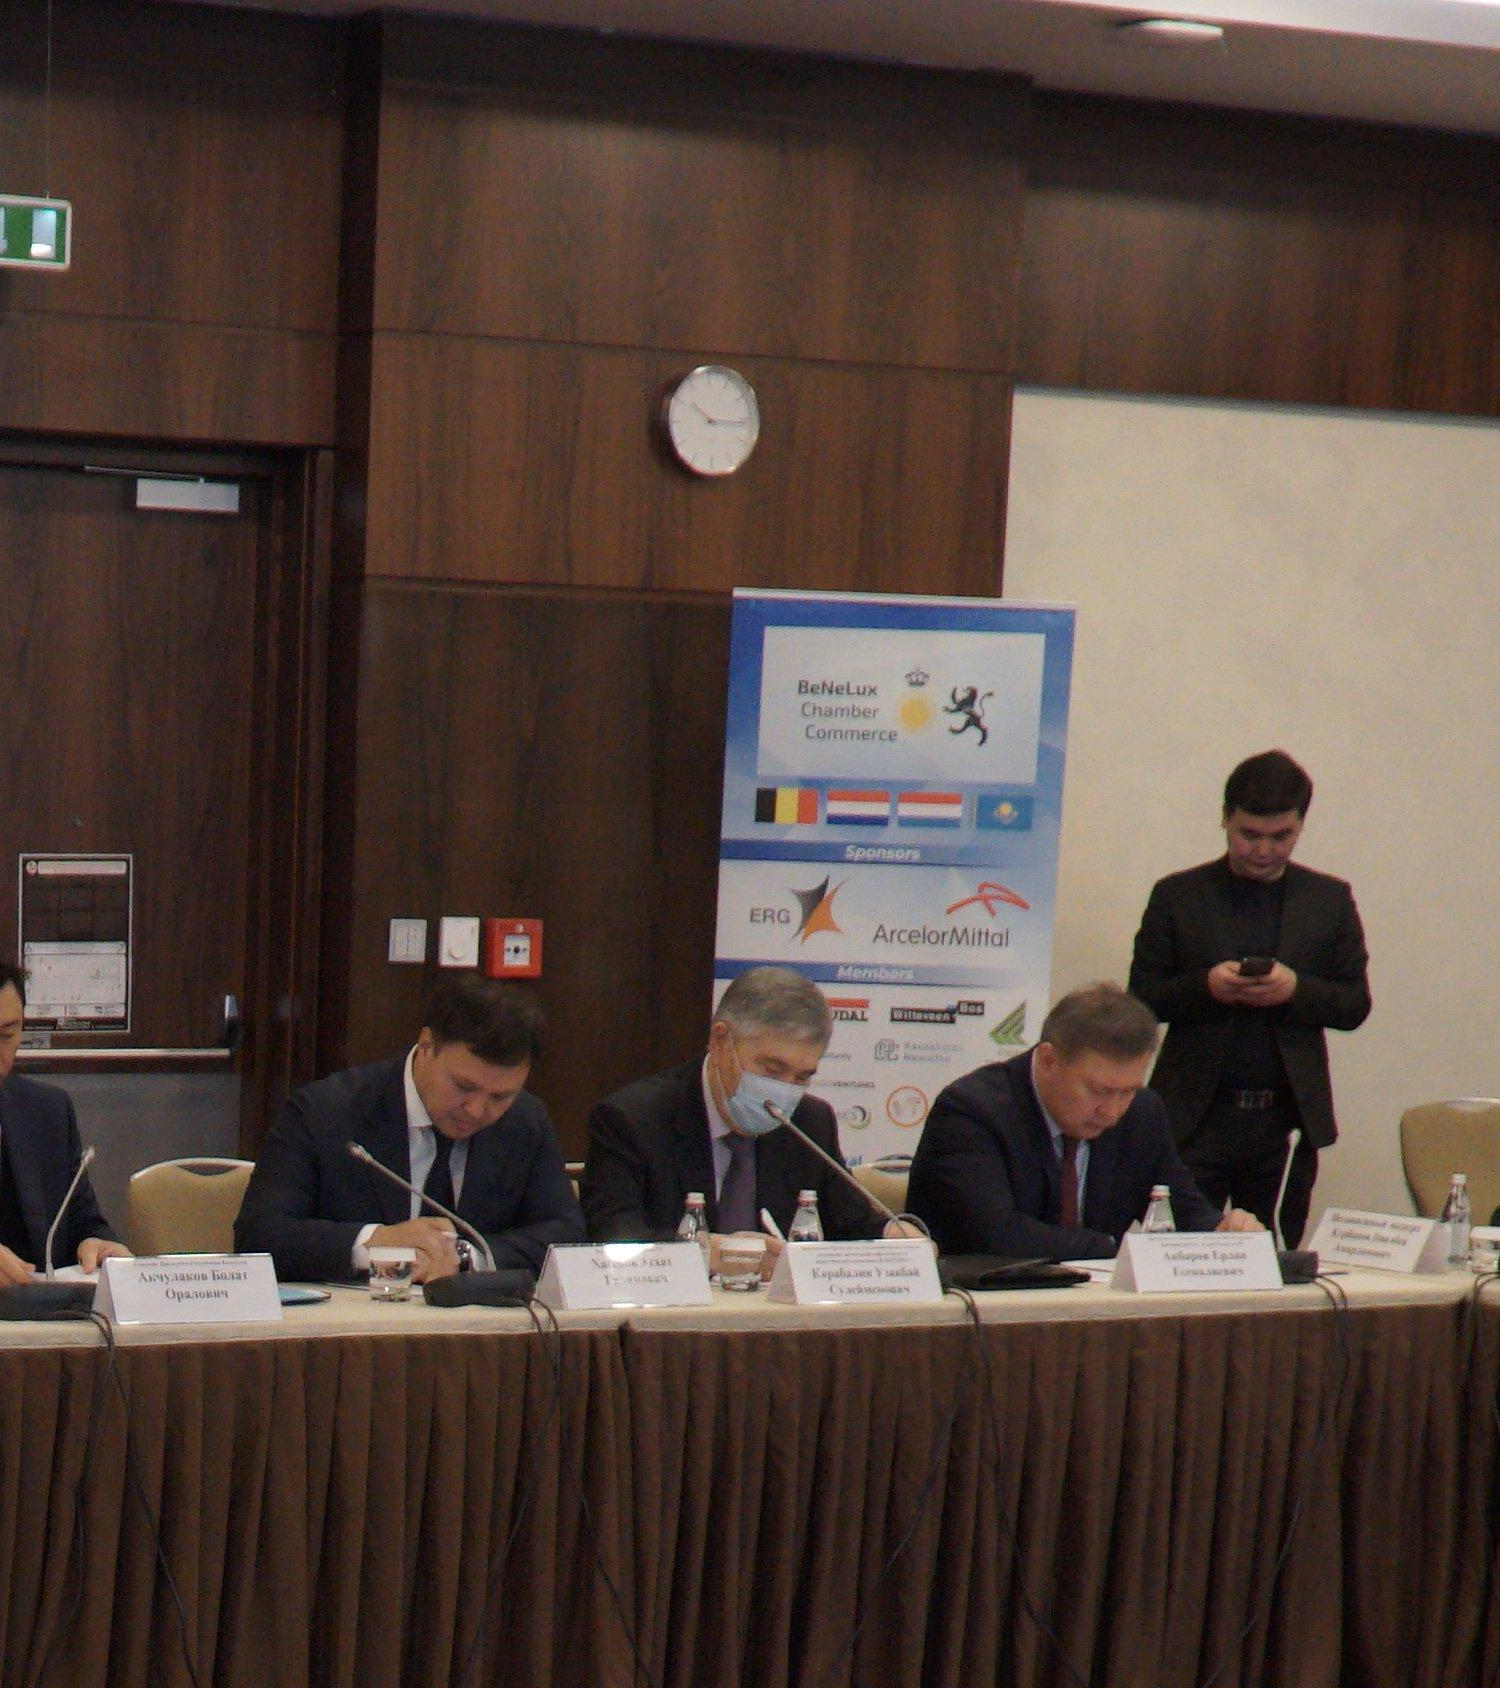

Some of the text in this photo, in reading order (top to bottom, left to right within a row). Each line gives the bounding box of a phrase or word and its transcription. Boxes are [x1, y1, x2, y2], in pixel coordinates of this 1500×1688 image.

[798, 680, 878, 697] BeNeLux
[801, 702, 880, 719] Chamber
[805, 724, 898, 742] Commerce
[845, 845, 921, 862] Sponsors
[749, 907, 791, 924] ERG
[872, 925, 1010, 948] ArcelorMittal
[837, 965, 914, 980] Members
[165, 1288, 229, 1302] Оралович
